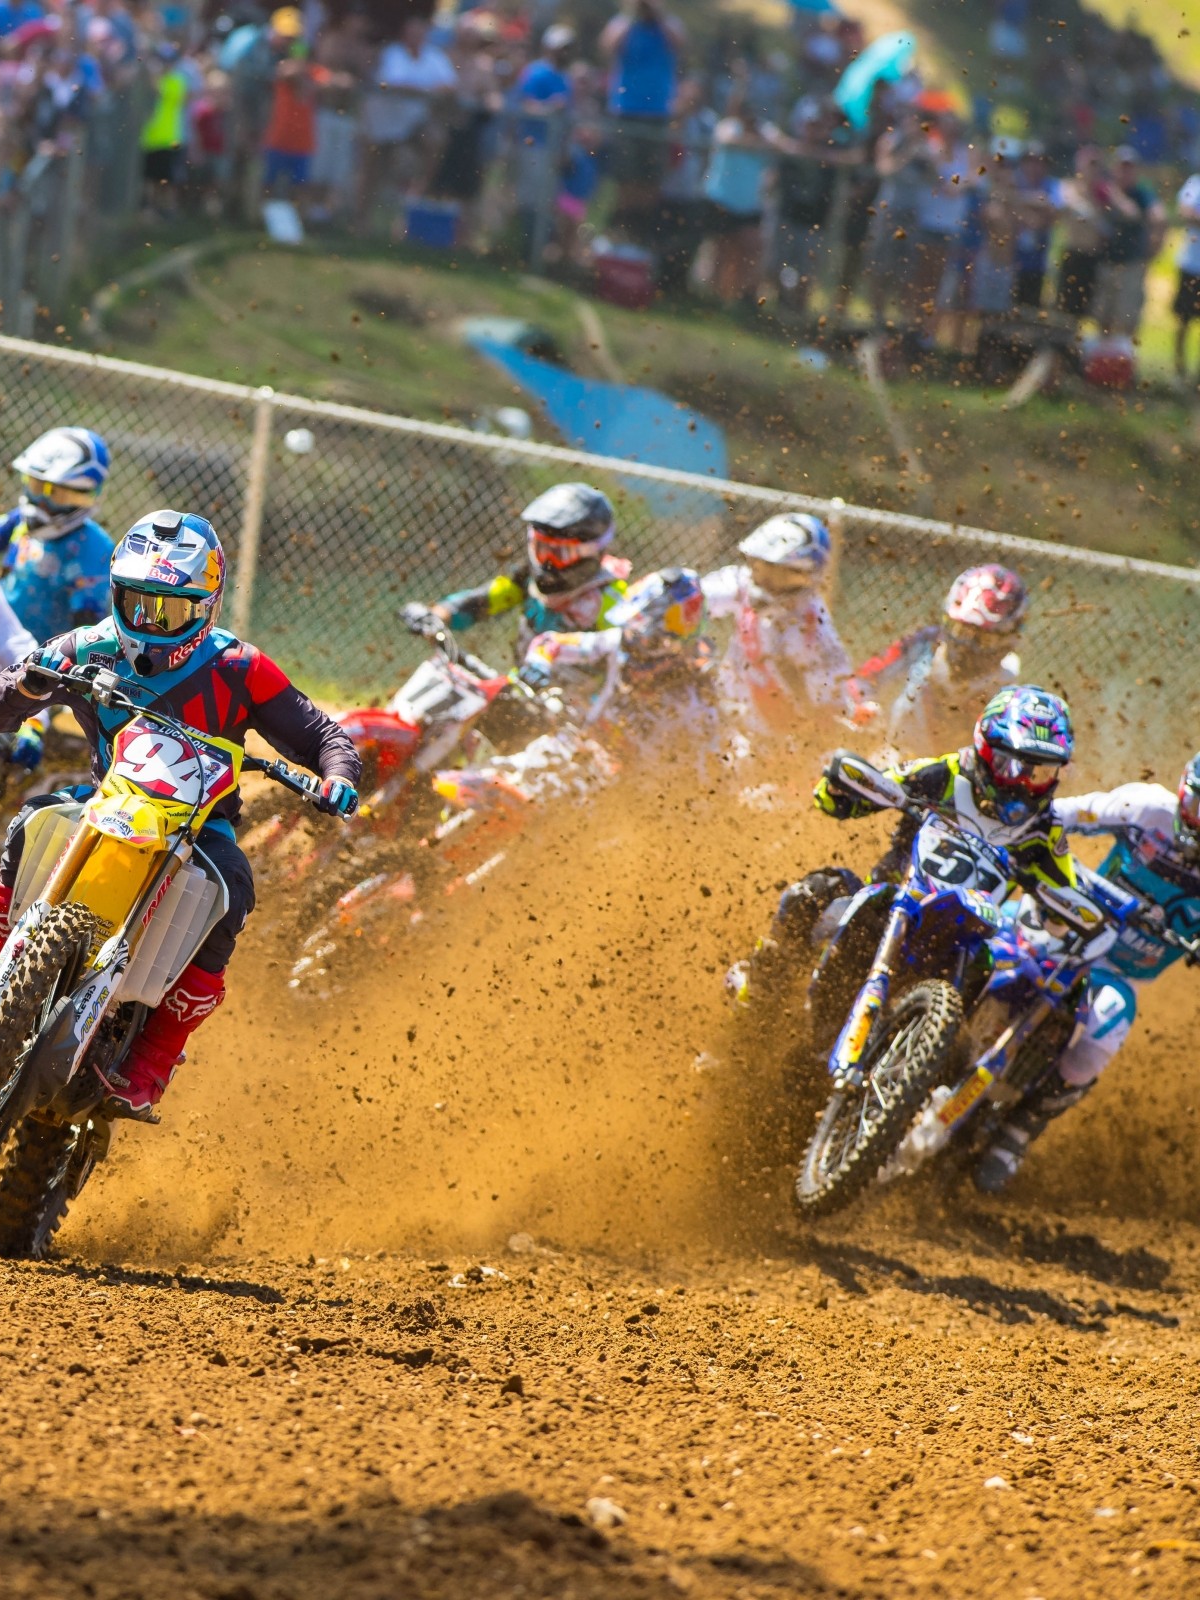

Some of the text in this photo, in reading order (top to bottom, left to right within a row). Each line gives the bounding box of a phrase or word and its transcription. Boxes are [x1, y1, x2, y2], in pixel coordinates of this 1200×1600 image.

[149, 566, 179, 585] Bull
[158, 726, 191, 745] LUCA
[193, 739, 208, 751] OIL
[114, 733, 211, 805] 94
[921, 838, 1002, 893] 51
[76, 985, 97, 1022] ACERBIS
